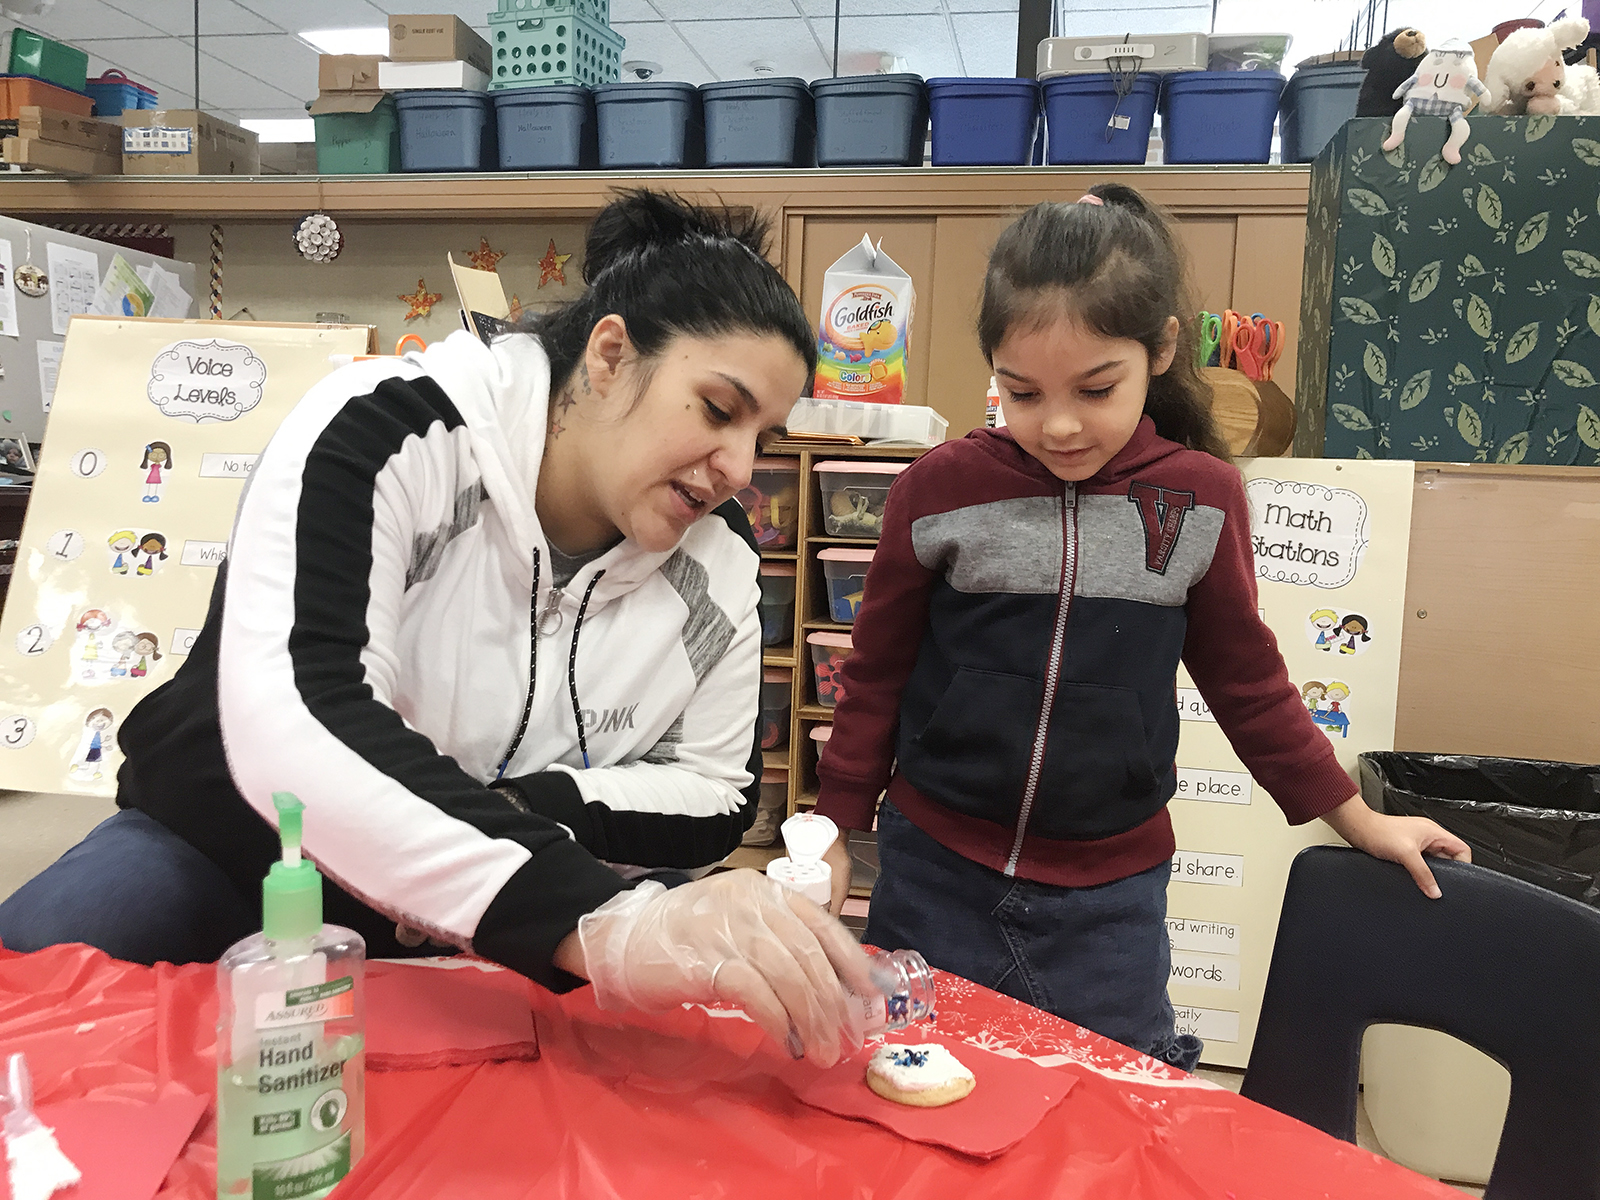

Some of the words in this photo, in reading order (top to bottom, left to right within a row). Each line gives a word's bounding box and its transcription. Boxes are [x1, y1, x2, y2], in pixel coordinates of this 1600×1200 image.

[415, 127, 456, 139] Halloween
[517, 123, 553, 132] Halloween
[834, 301, 893, 328] Goldfish
[846, 321, 870, 330] BAKED
[186, 356, 234, 377] Voice
[839, 370, 873, 383] Colors
[173, 383, 237, 407] Levels
[79, 452, 98, 476] 0
[222, 460, 239, 473] No
[1264, 503, 1332, 533] Math
[56, 532, 74, 558] 1
[1154, 533, 1172, 566] VARSITY
[1251, 534, 1340, 567] Stations
[27, 626, 44, 654] 2
[5, 717, 28, 744] 3
[1196, 776, 1245, 797] place.
[1186, 858, 1239, 879] share.
[1190, 922, 1235, 940] writing
[1171, 964, 1226, 982] words.
[264, 1003, 327, 1021] ASSURED
[260, 1032, 302, 1046] Instant
[259, 1040, 314, 1068] Hand
[258, 1059, 346, 1095] Sanitizer
